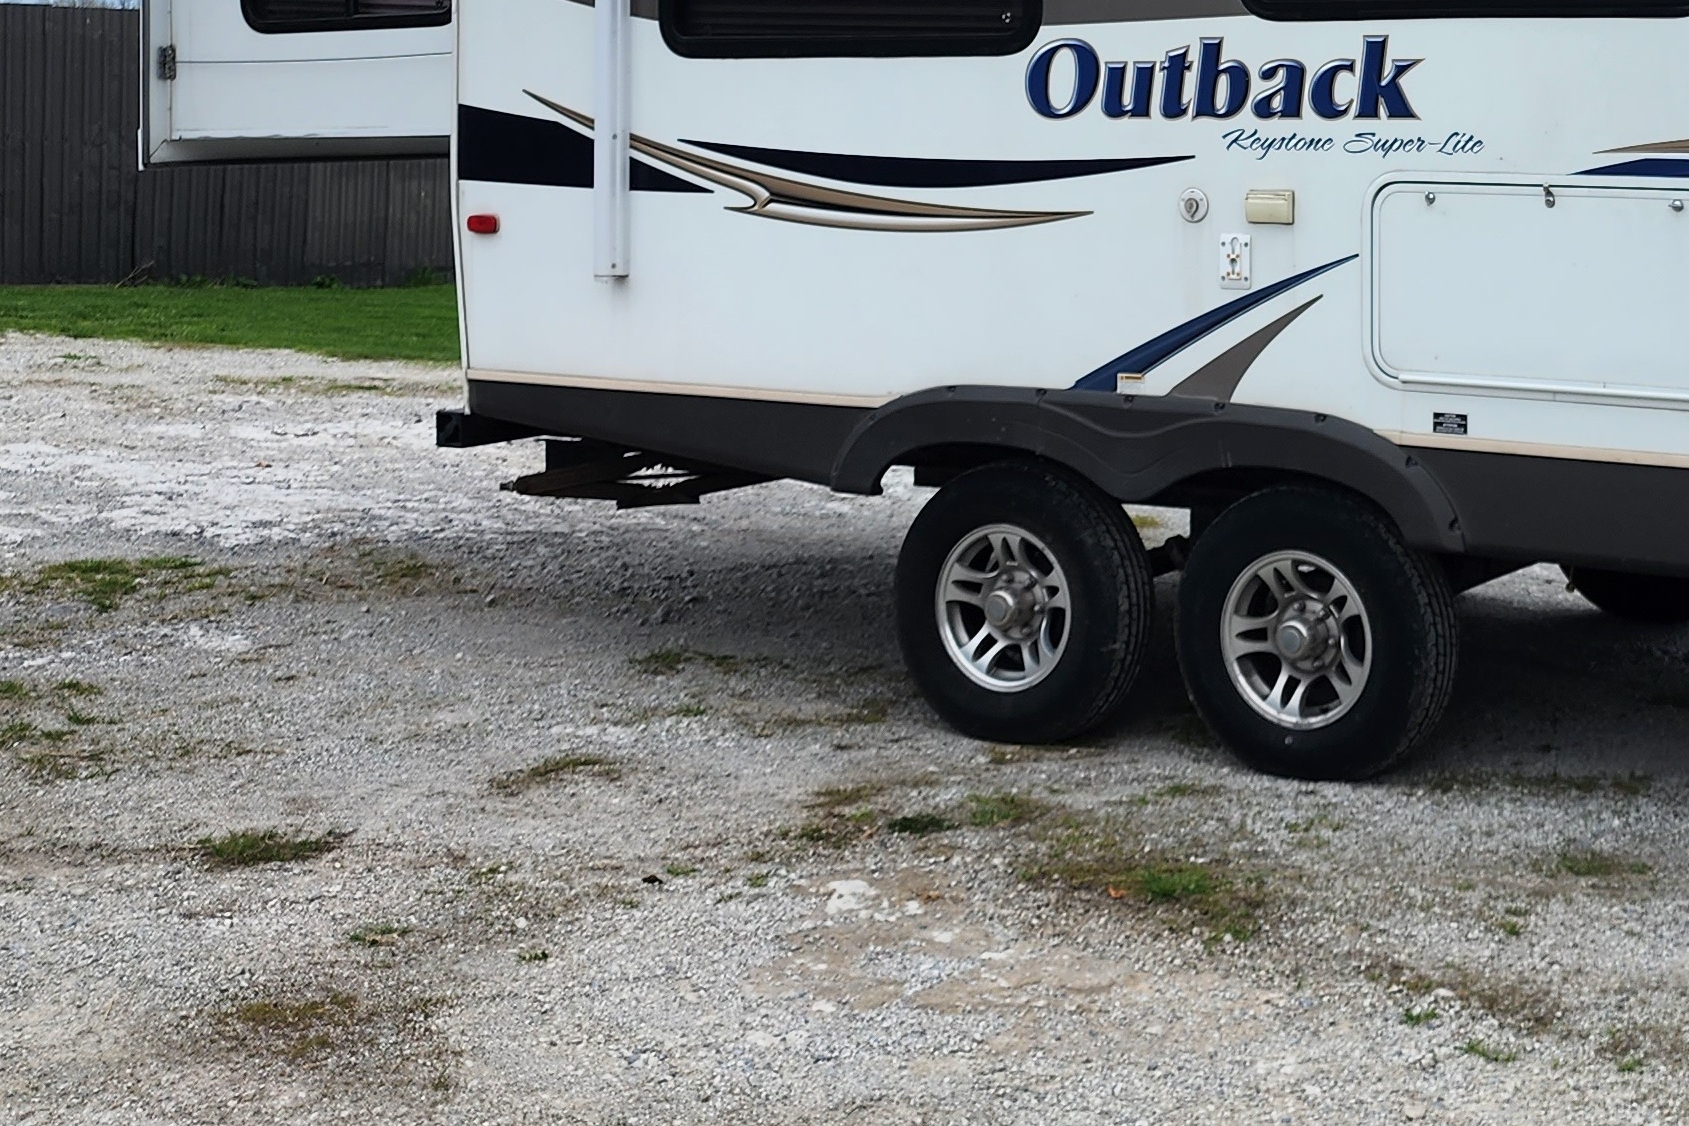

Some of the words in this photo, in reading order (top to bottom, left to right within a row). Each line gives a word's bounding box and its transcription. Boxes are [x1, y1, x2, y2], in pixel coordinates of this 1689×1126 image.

[1025, 35, 1426, 121] Outback
[1222, 129, 1335, 160] Keystone
[1343, 132, 1485, 159] Super-Lite
